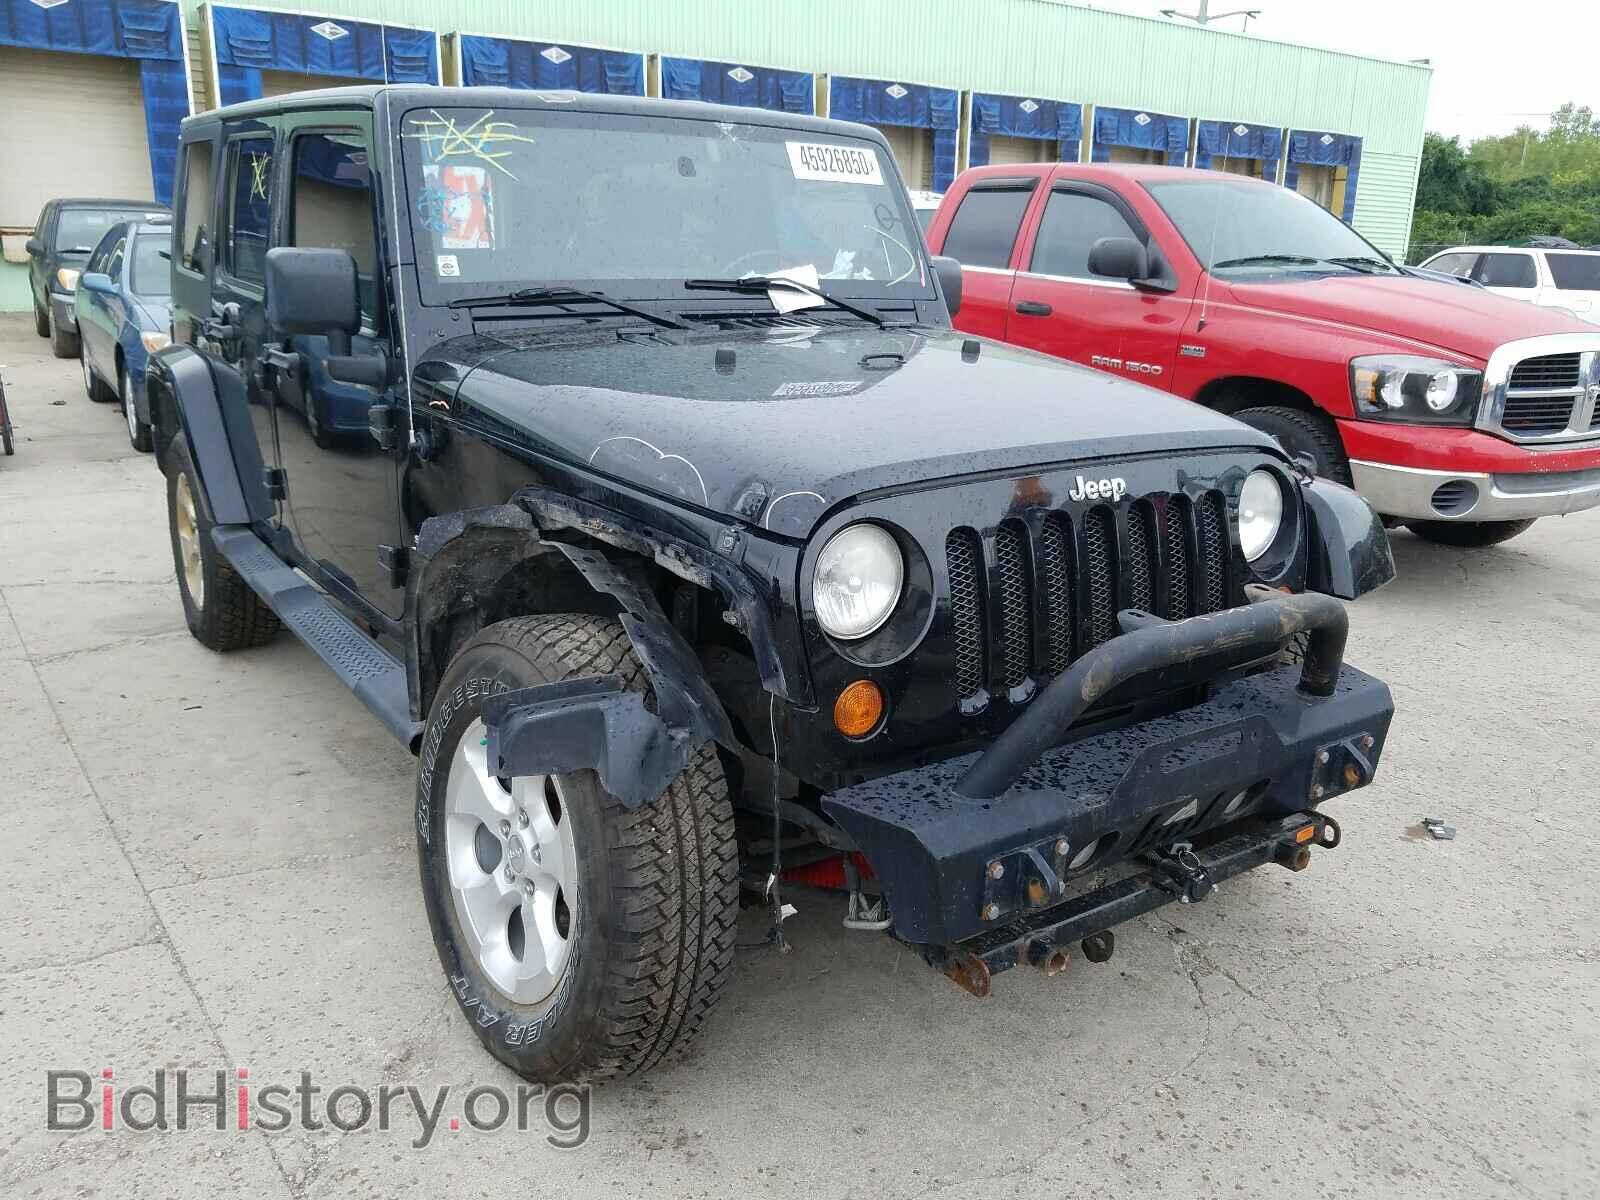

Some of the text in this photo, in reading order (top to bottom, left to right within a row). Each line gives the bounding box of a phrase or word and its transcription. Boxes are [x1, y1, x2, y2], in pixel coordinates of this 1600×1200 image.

[800, 145, 870, 175] 45926850
[1091, 355, 1162, 375] RAM 1500
[1069, 475, 1126, 503] Jeep
